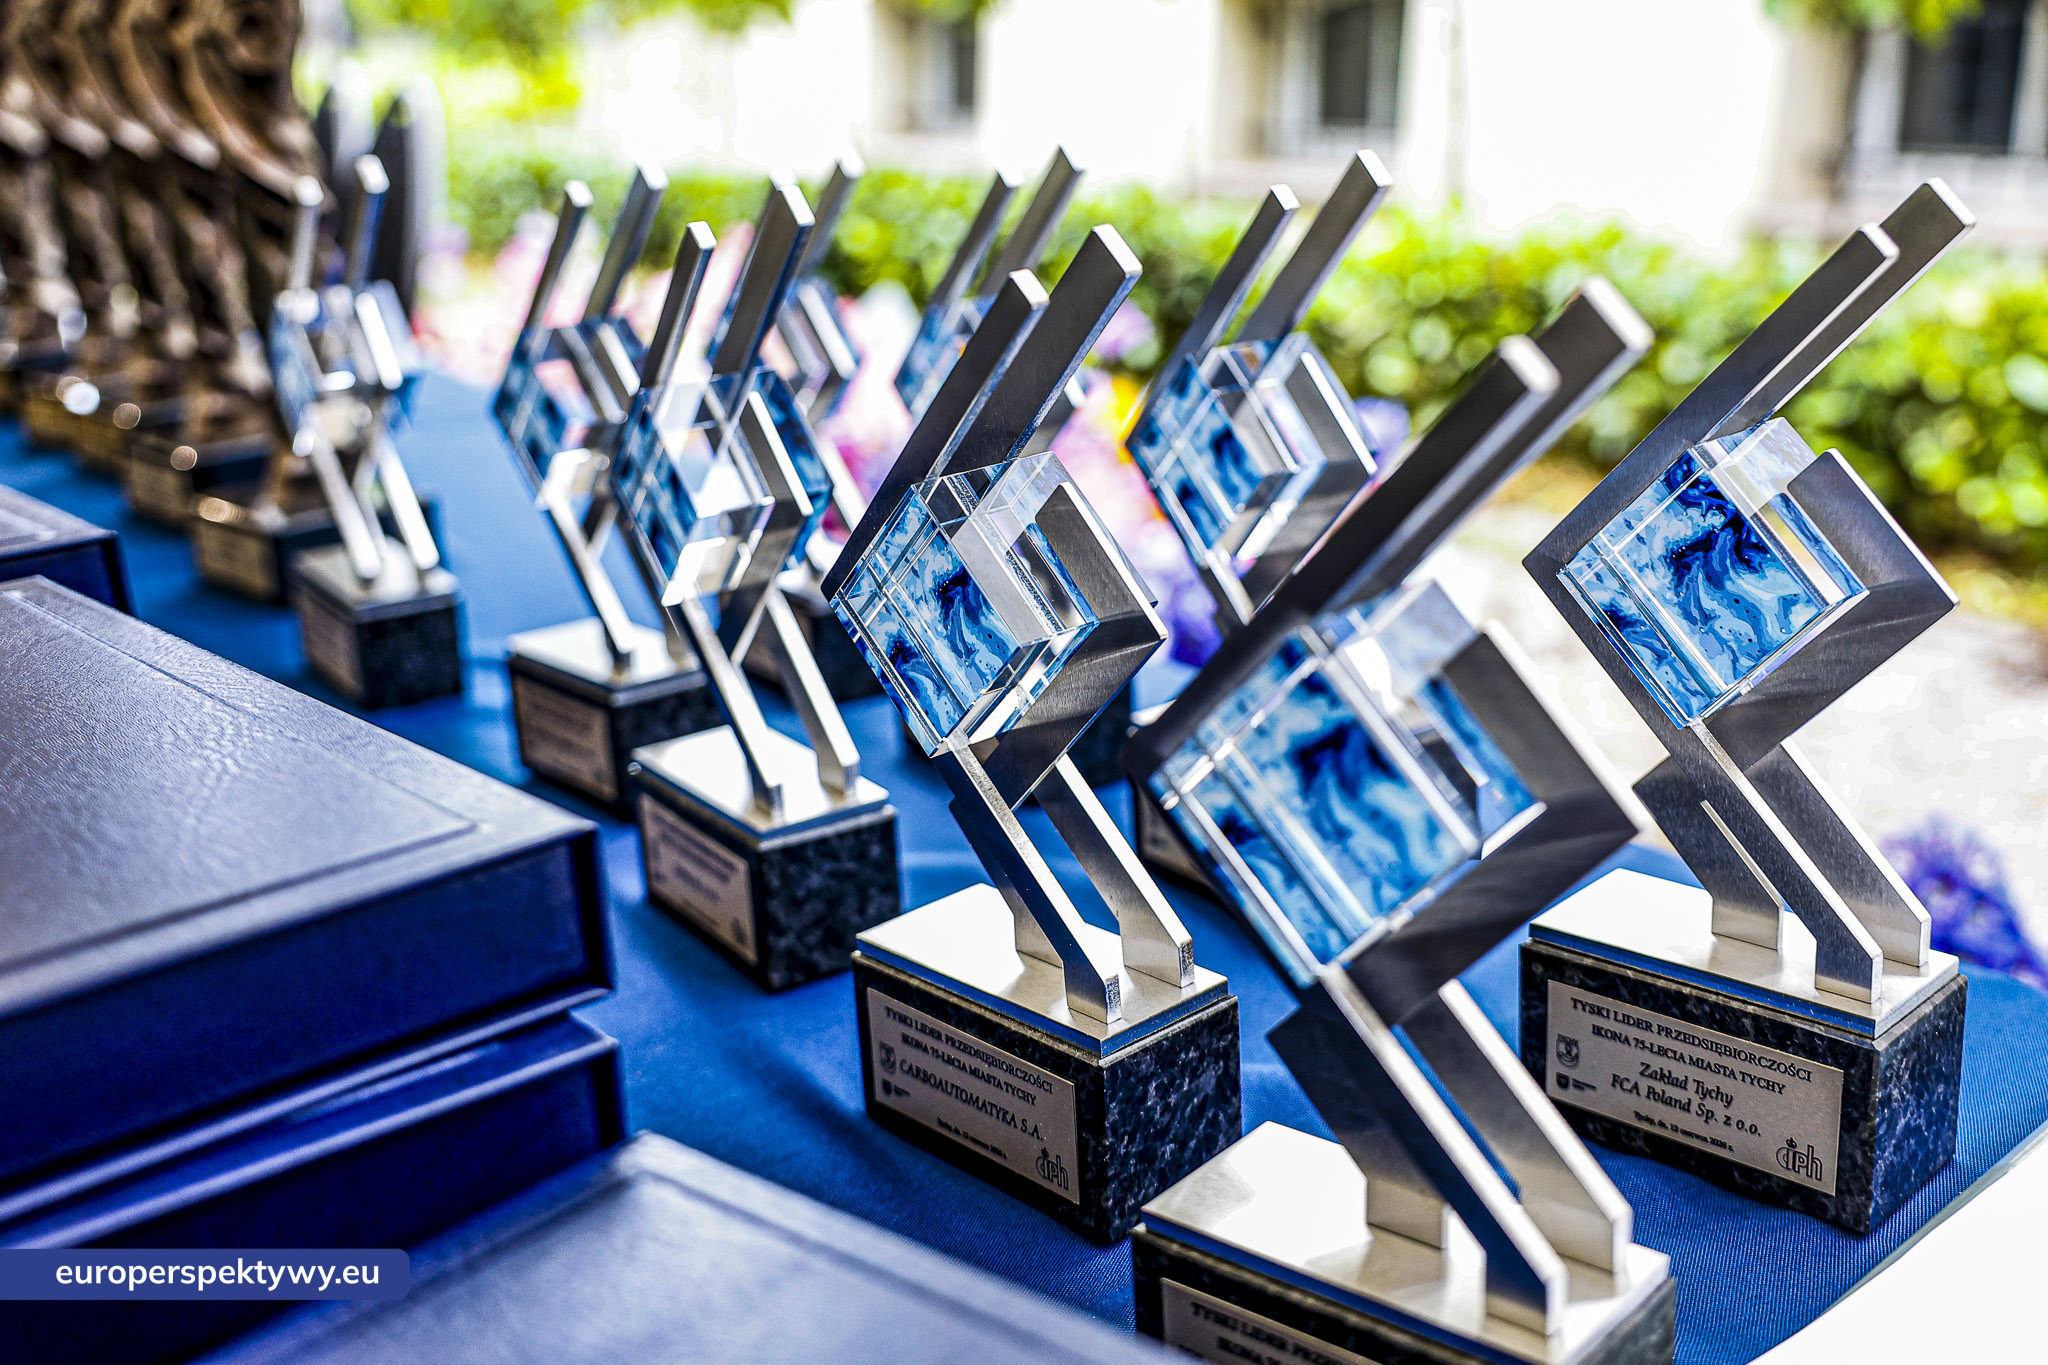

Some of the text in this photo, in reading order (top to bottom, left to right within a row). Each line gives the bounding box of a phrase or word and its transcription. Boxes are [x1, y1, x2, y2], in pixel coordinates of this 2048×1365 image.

[885, 1006, 1054, 1094] TYSKI LIDER PRZEDSIĘBIORCZOŚCI
[902, 1032, 930, 1055] IKONA
[969, 1063, 1003, 1089] MIASTA
[1002, 1082, 1036, 1105] TYCHY
[1571, 997, 1812, 1082] TYSKI LIDER PRZEDSIĘBIORCZOŚCI
[1591, 1024, 1786, 1095] IKONA 75-LECIA MIASTA TYCHY
[899, 1058, 1018, 1128] CARBOAUTOMATYKA
[1020, 1118, 1044, 1140] S.A.
[1610, 1072, 1641, 1096] FCA
[1646, 1085, 1692, 1114] Poland
[1695, 1102, 1718, 1124] Sp.
[1723, 1114, 1732, 1126] z
[1736, 1118, 1762, 1137] o.o.
[1639, 1062, 1734, 1108] Zakład Tychy
